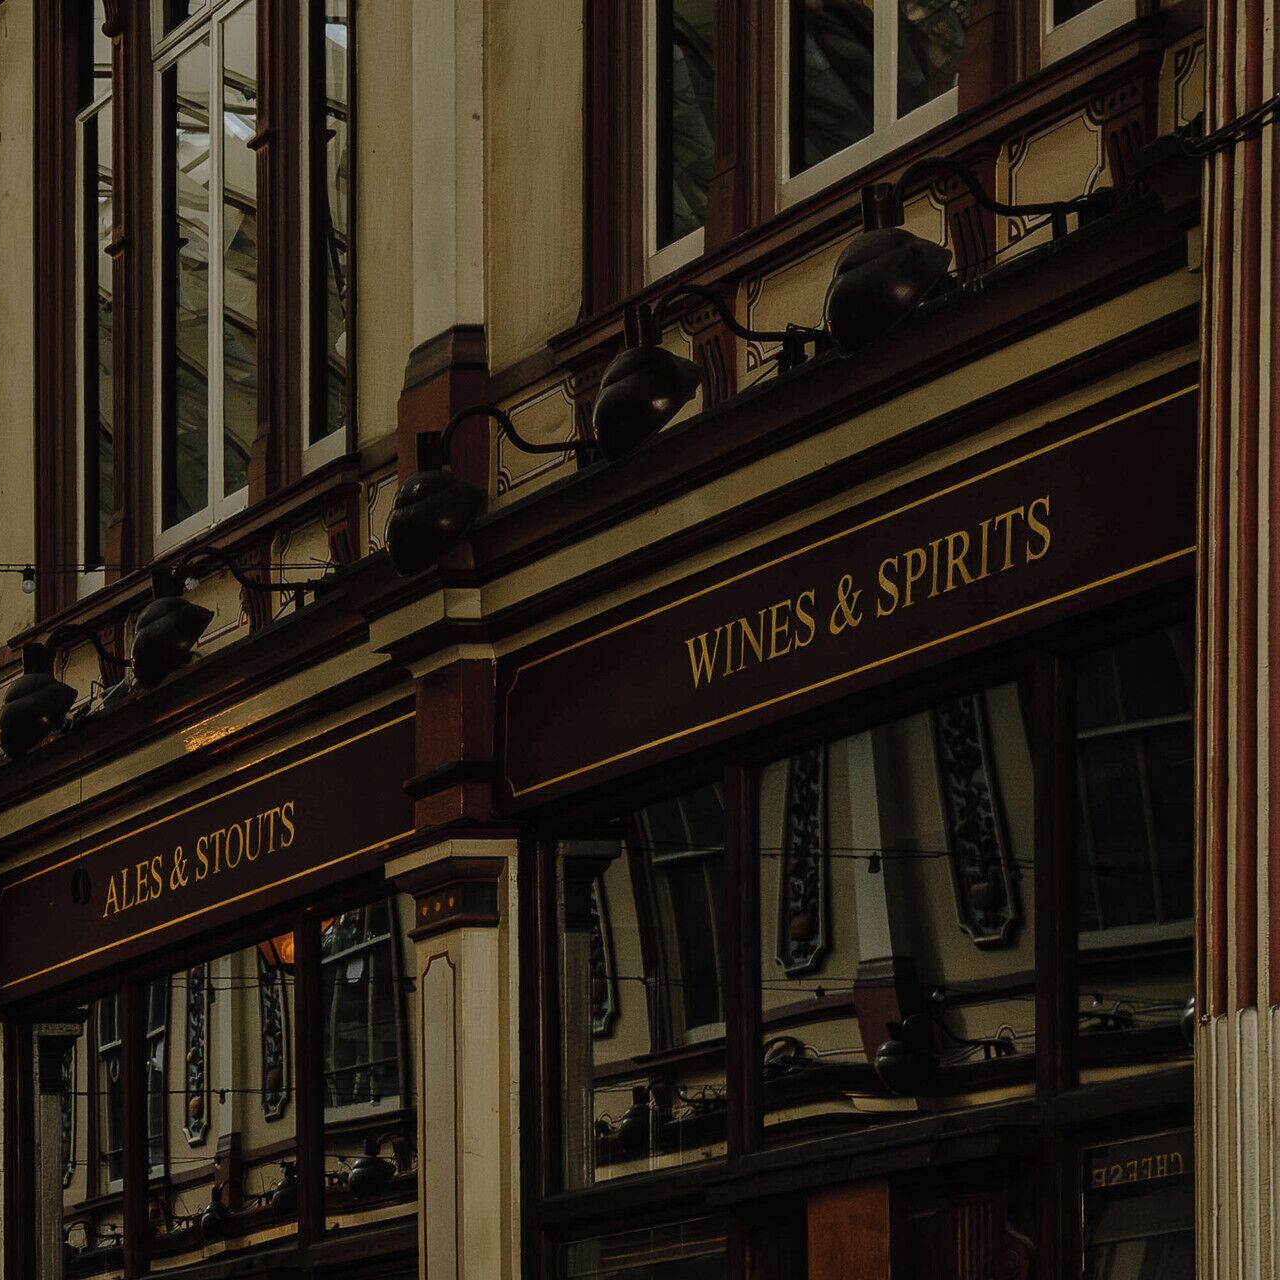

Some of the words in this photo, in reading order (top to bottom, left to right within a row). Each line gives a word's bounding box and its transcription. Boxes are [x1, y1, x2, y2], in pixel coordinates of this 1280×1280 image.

[686, 588, 816, 690] WINES
[829, 572, 863, 635] &
[876, 495, 1053, 619] SPIRITS
[102, 860, 163, 919] ALES
[168, 844, 188, 892] &
[195, 801, 297, 882] STOUTS
